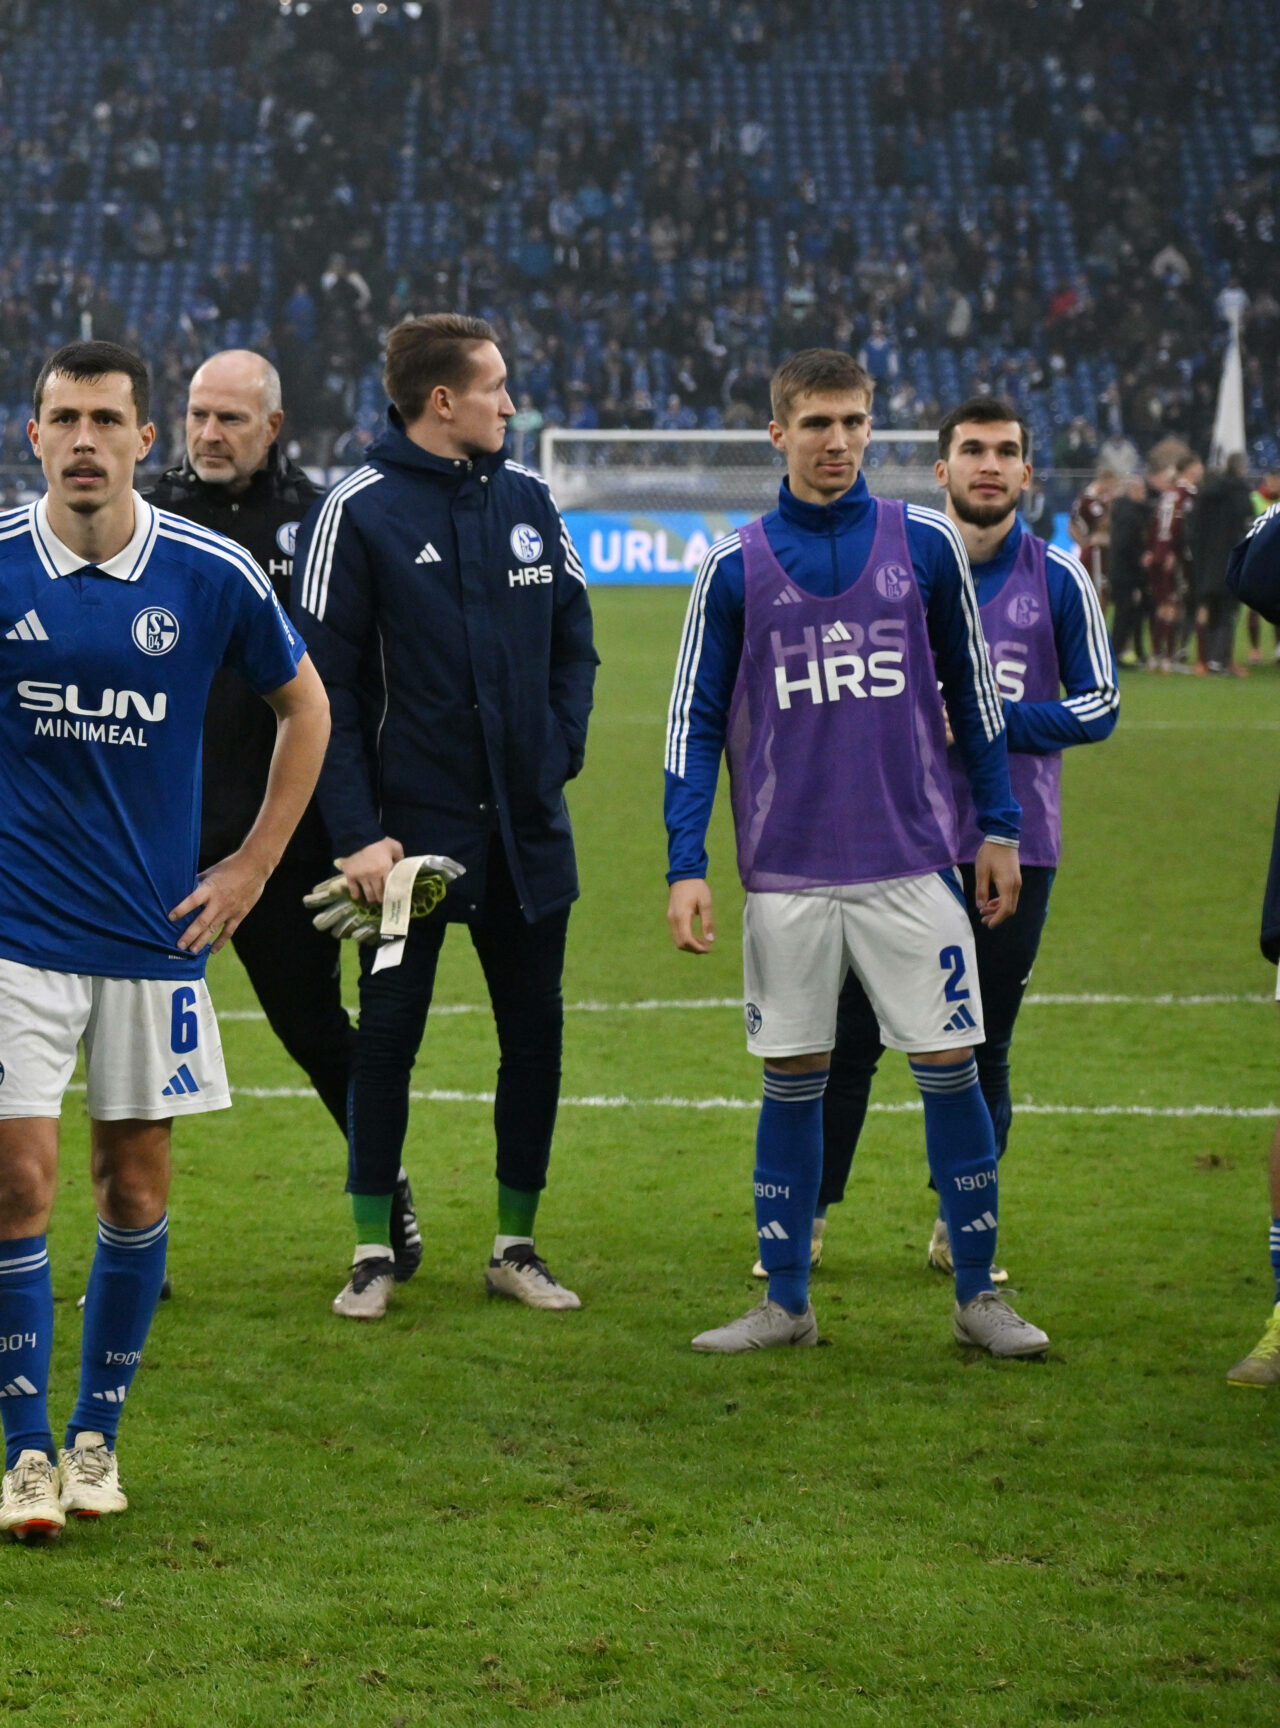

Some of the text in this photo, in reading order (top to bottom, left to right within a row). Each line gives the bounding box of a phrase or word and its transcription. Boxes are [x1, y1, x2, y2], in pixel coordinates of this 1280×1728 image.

[508, 565, 553, 588] HRS
[17, 680, 167, 722] SUN
[774, 651, 906, 710] HRS
[34, 717, 148, 747] MINIMEAL
[939, 945, 970, 1002] 2
[170, 986, 198, 1054] 6
[952, 1169, 997, 1192] 1904
